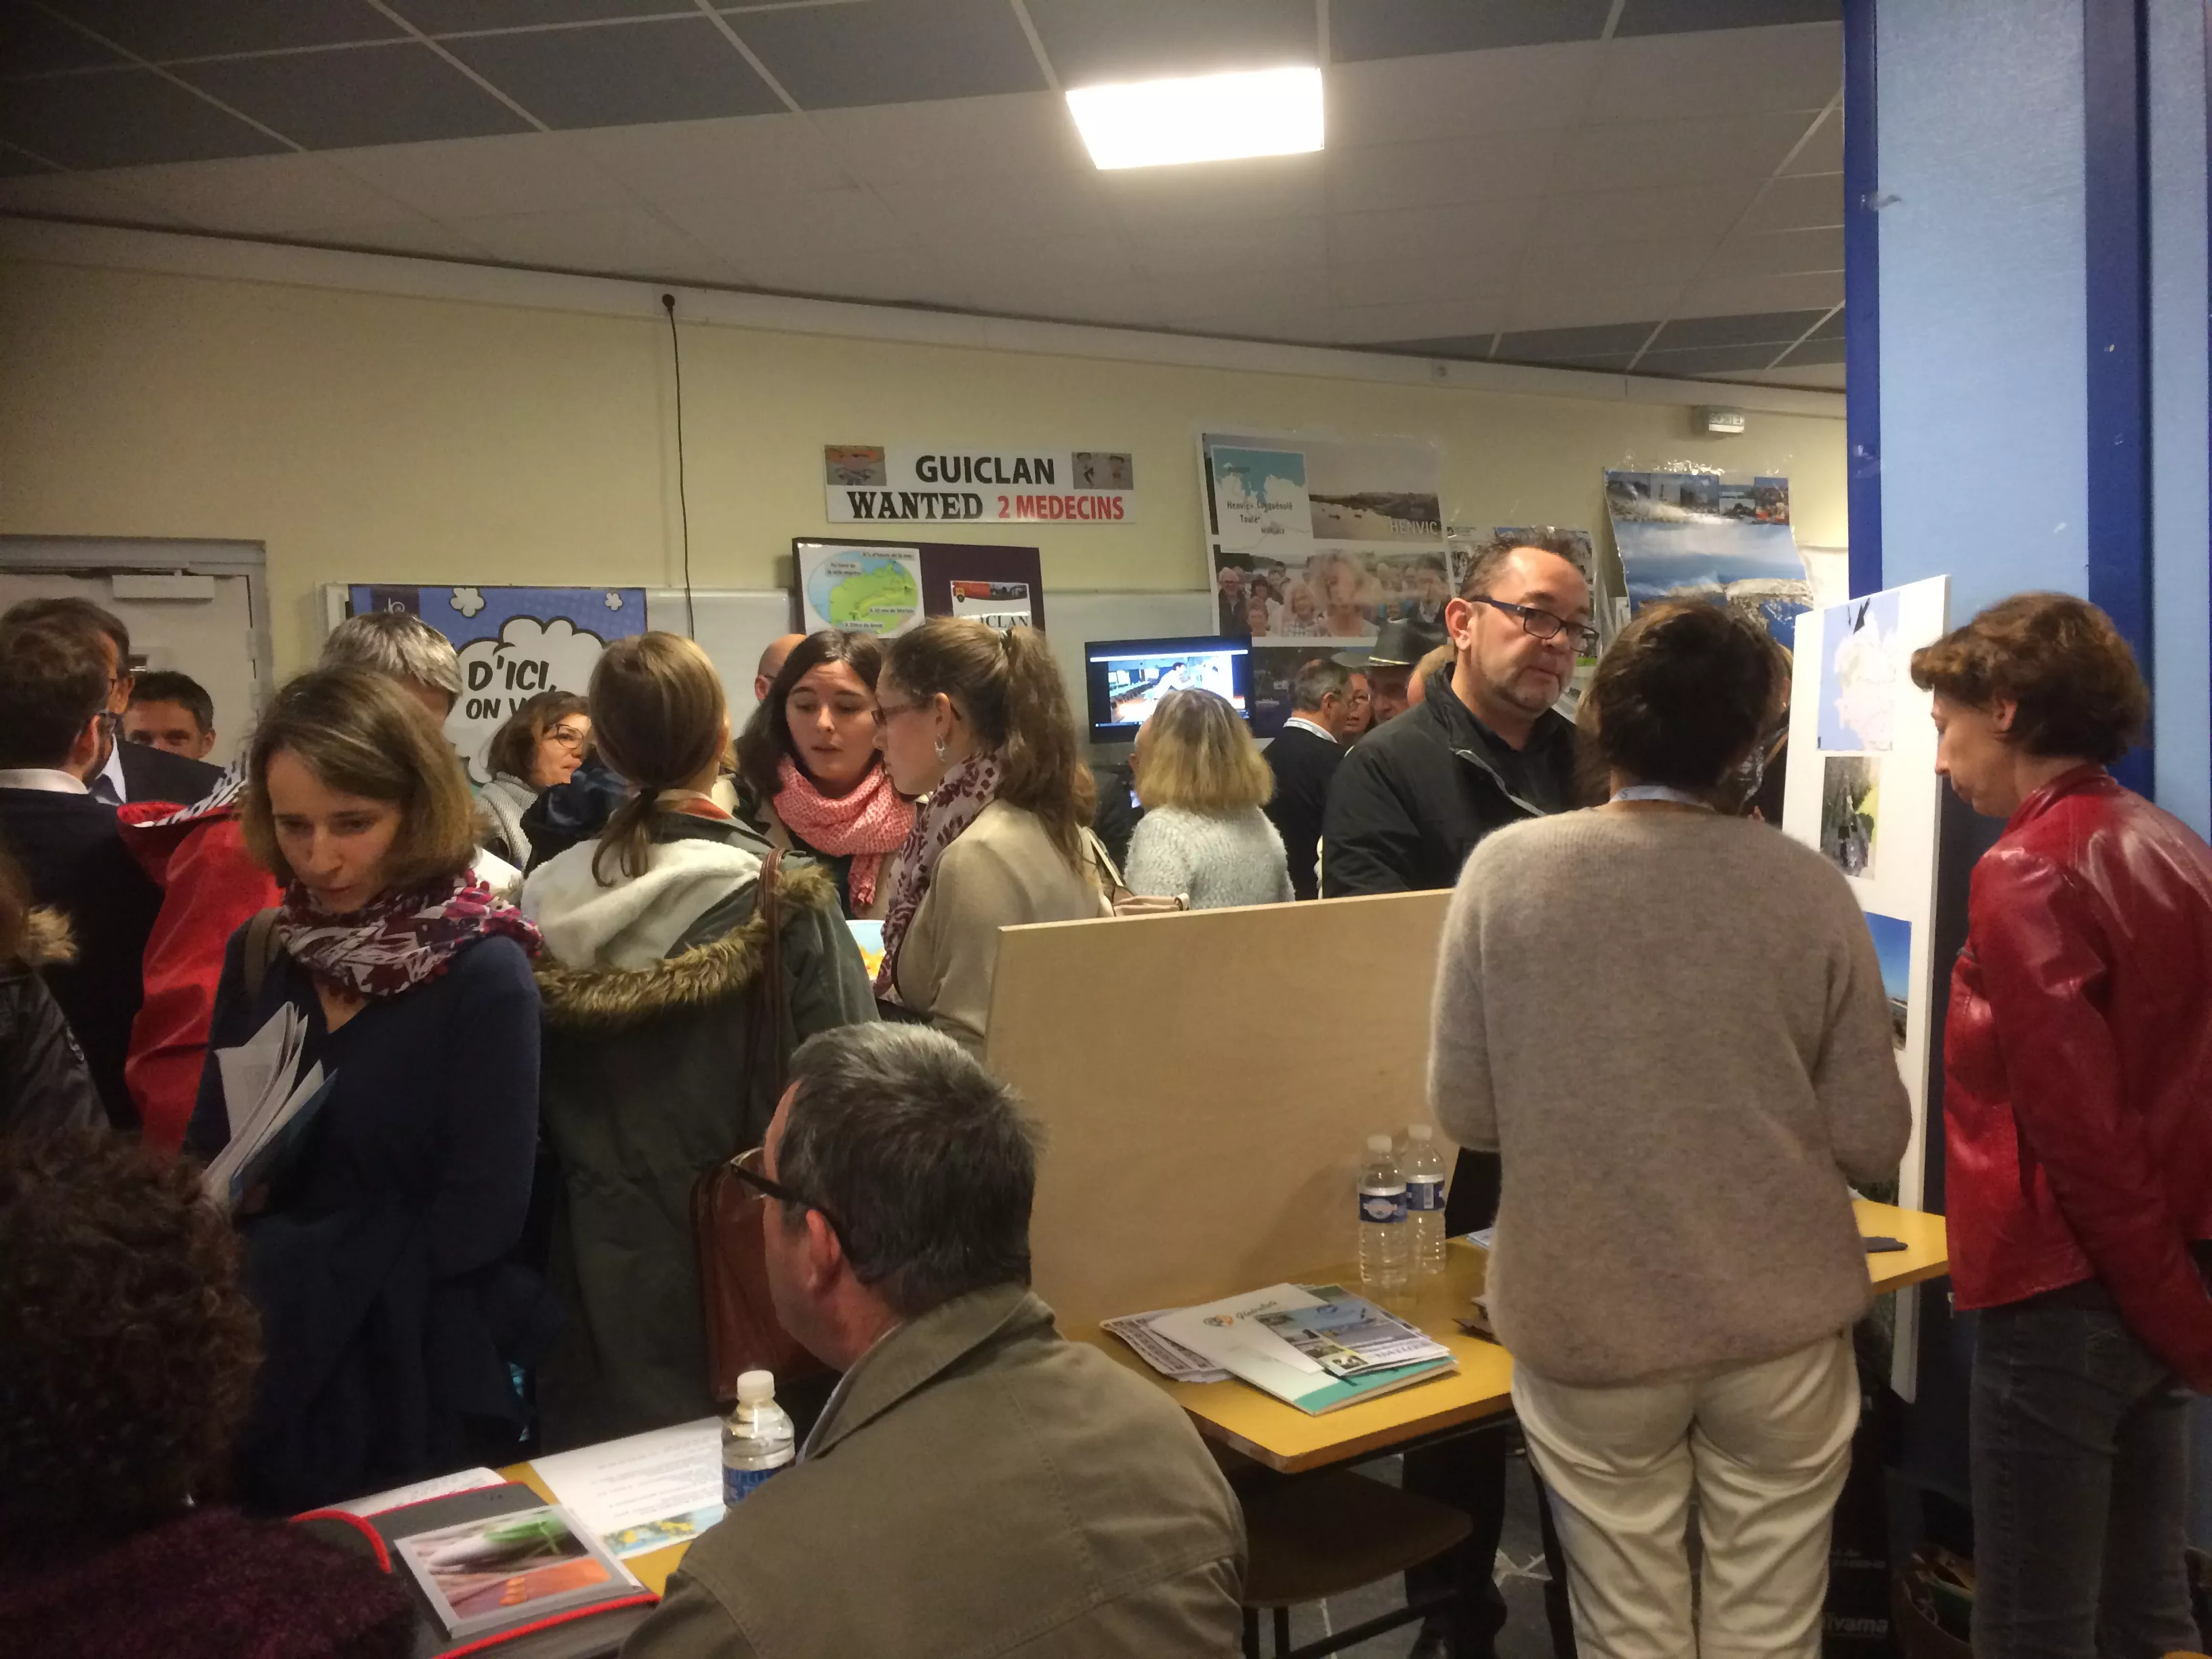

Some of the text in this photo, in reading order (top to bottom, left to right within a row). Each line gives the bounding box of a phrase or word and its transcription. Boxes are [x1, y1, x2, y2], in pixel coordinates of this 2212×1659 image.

[916, 455, 1055, 485] GUICLAN
[846, 491, 1124, 520] WANTED 2 MEDECINS
[1390, 518, 1437, 535] HENVIC
[468, 655, 556, 693] D'ICI,
[466, 698, 501, 720] ON
